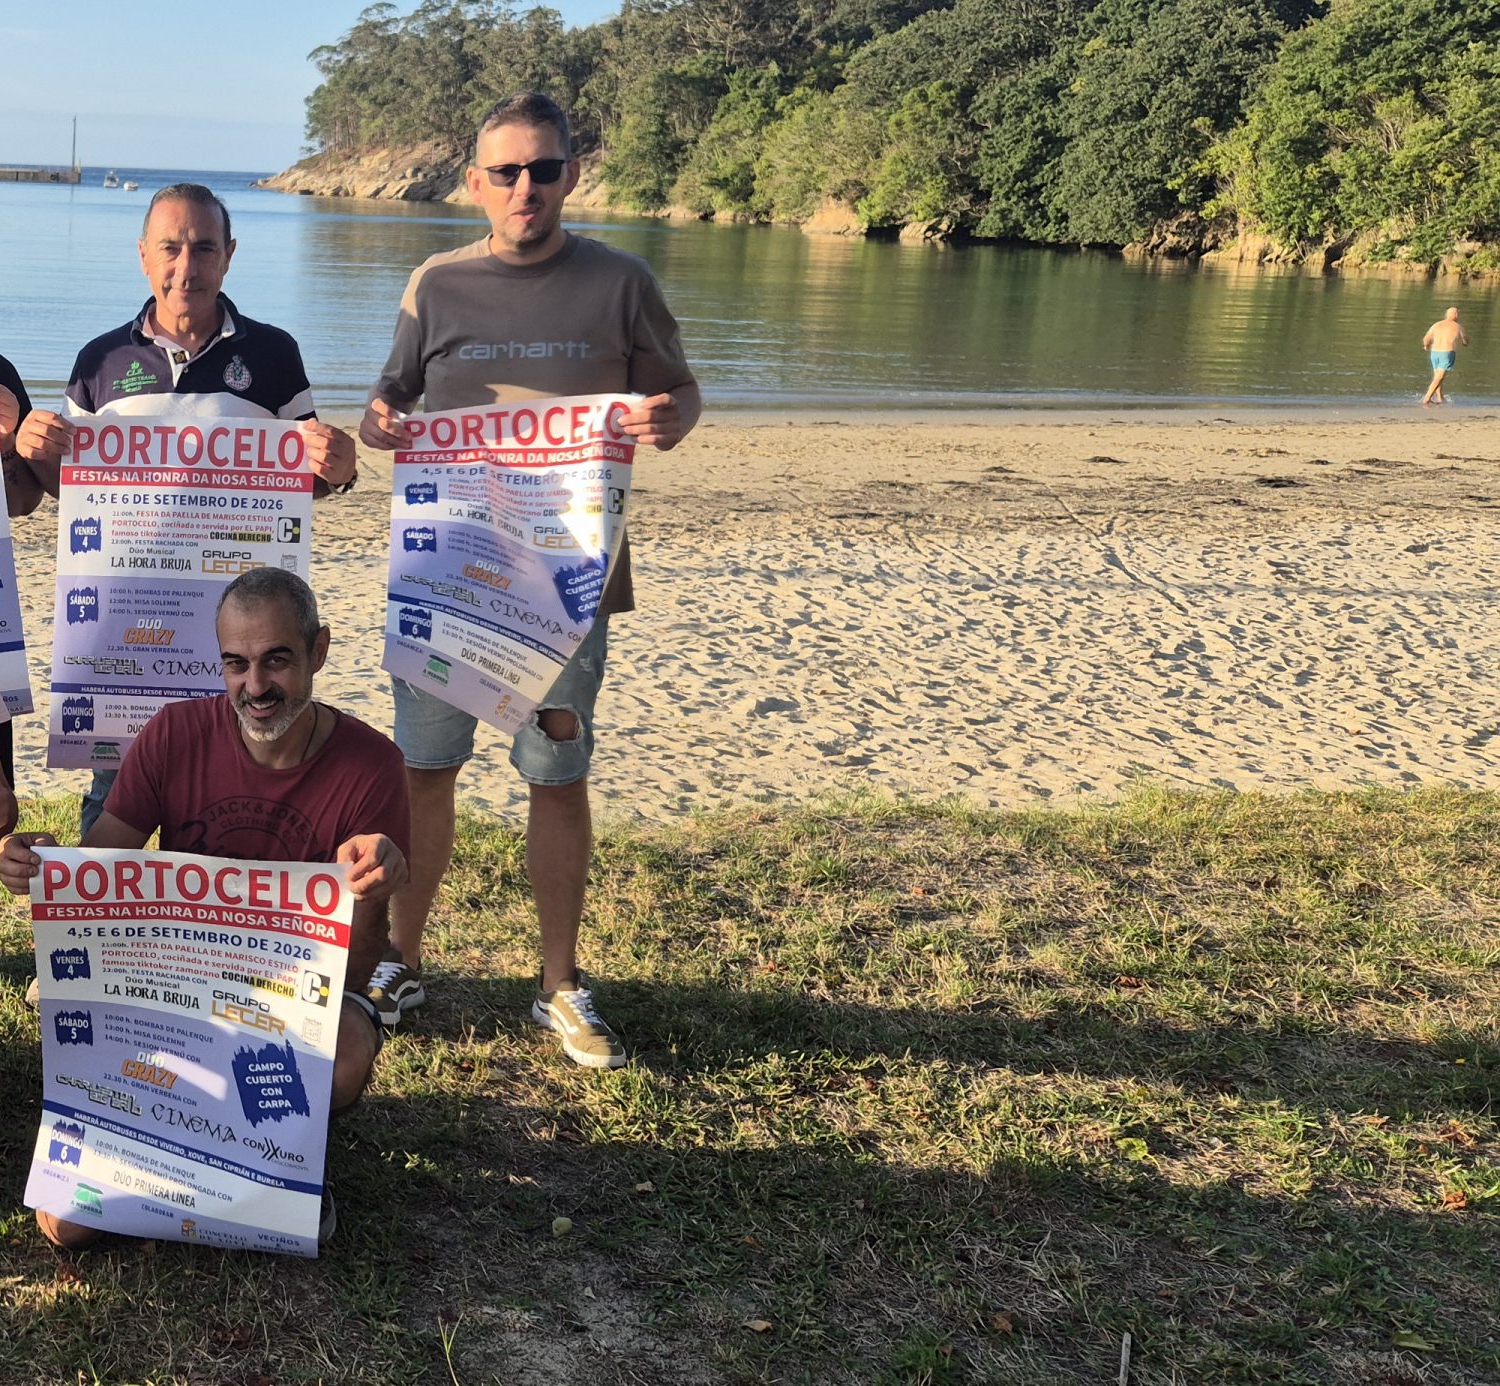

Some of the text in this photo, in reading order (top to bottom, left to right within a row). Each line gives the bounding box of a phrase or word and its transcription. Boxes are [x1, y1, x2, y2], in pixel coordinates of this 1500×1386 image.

[459, 340, 591, 359] carhartt
[404, 402, 631, 449] PORTOCELO
[72, 425, 304, 470] PORTOCELO
[406, 453, 453, 461] FESTAS
[478, 451, 524, 463] HONRA
[527, 454, 545, 463] DA
[547, 449, 579, 463] NOSA
[72, 471, 302, 488] FESTAS NA HONRA DA NOSA SEÑORA
[470, 467, 486, 475] DE
[87, 493, 283, 510] 4,5 E 6 DE SETEMBRO DE 2026
[209, 801, 250, 822] JACK
[254, 804, 265, 814] &
[44, 860, 340, 915] PORTOCELO
[47, 906, 336, 940] FESTAS NA HONRA DA NOSA SEÑORA
[68, 927, 311, 960] 4,5 E 6 DE SETEMBRO DE 2026
